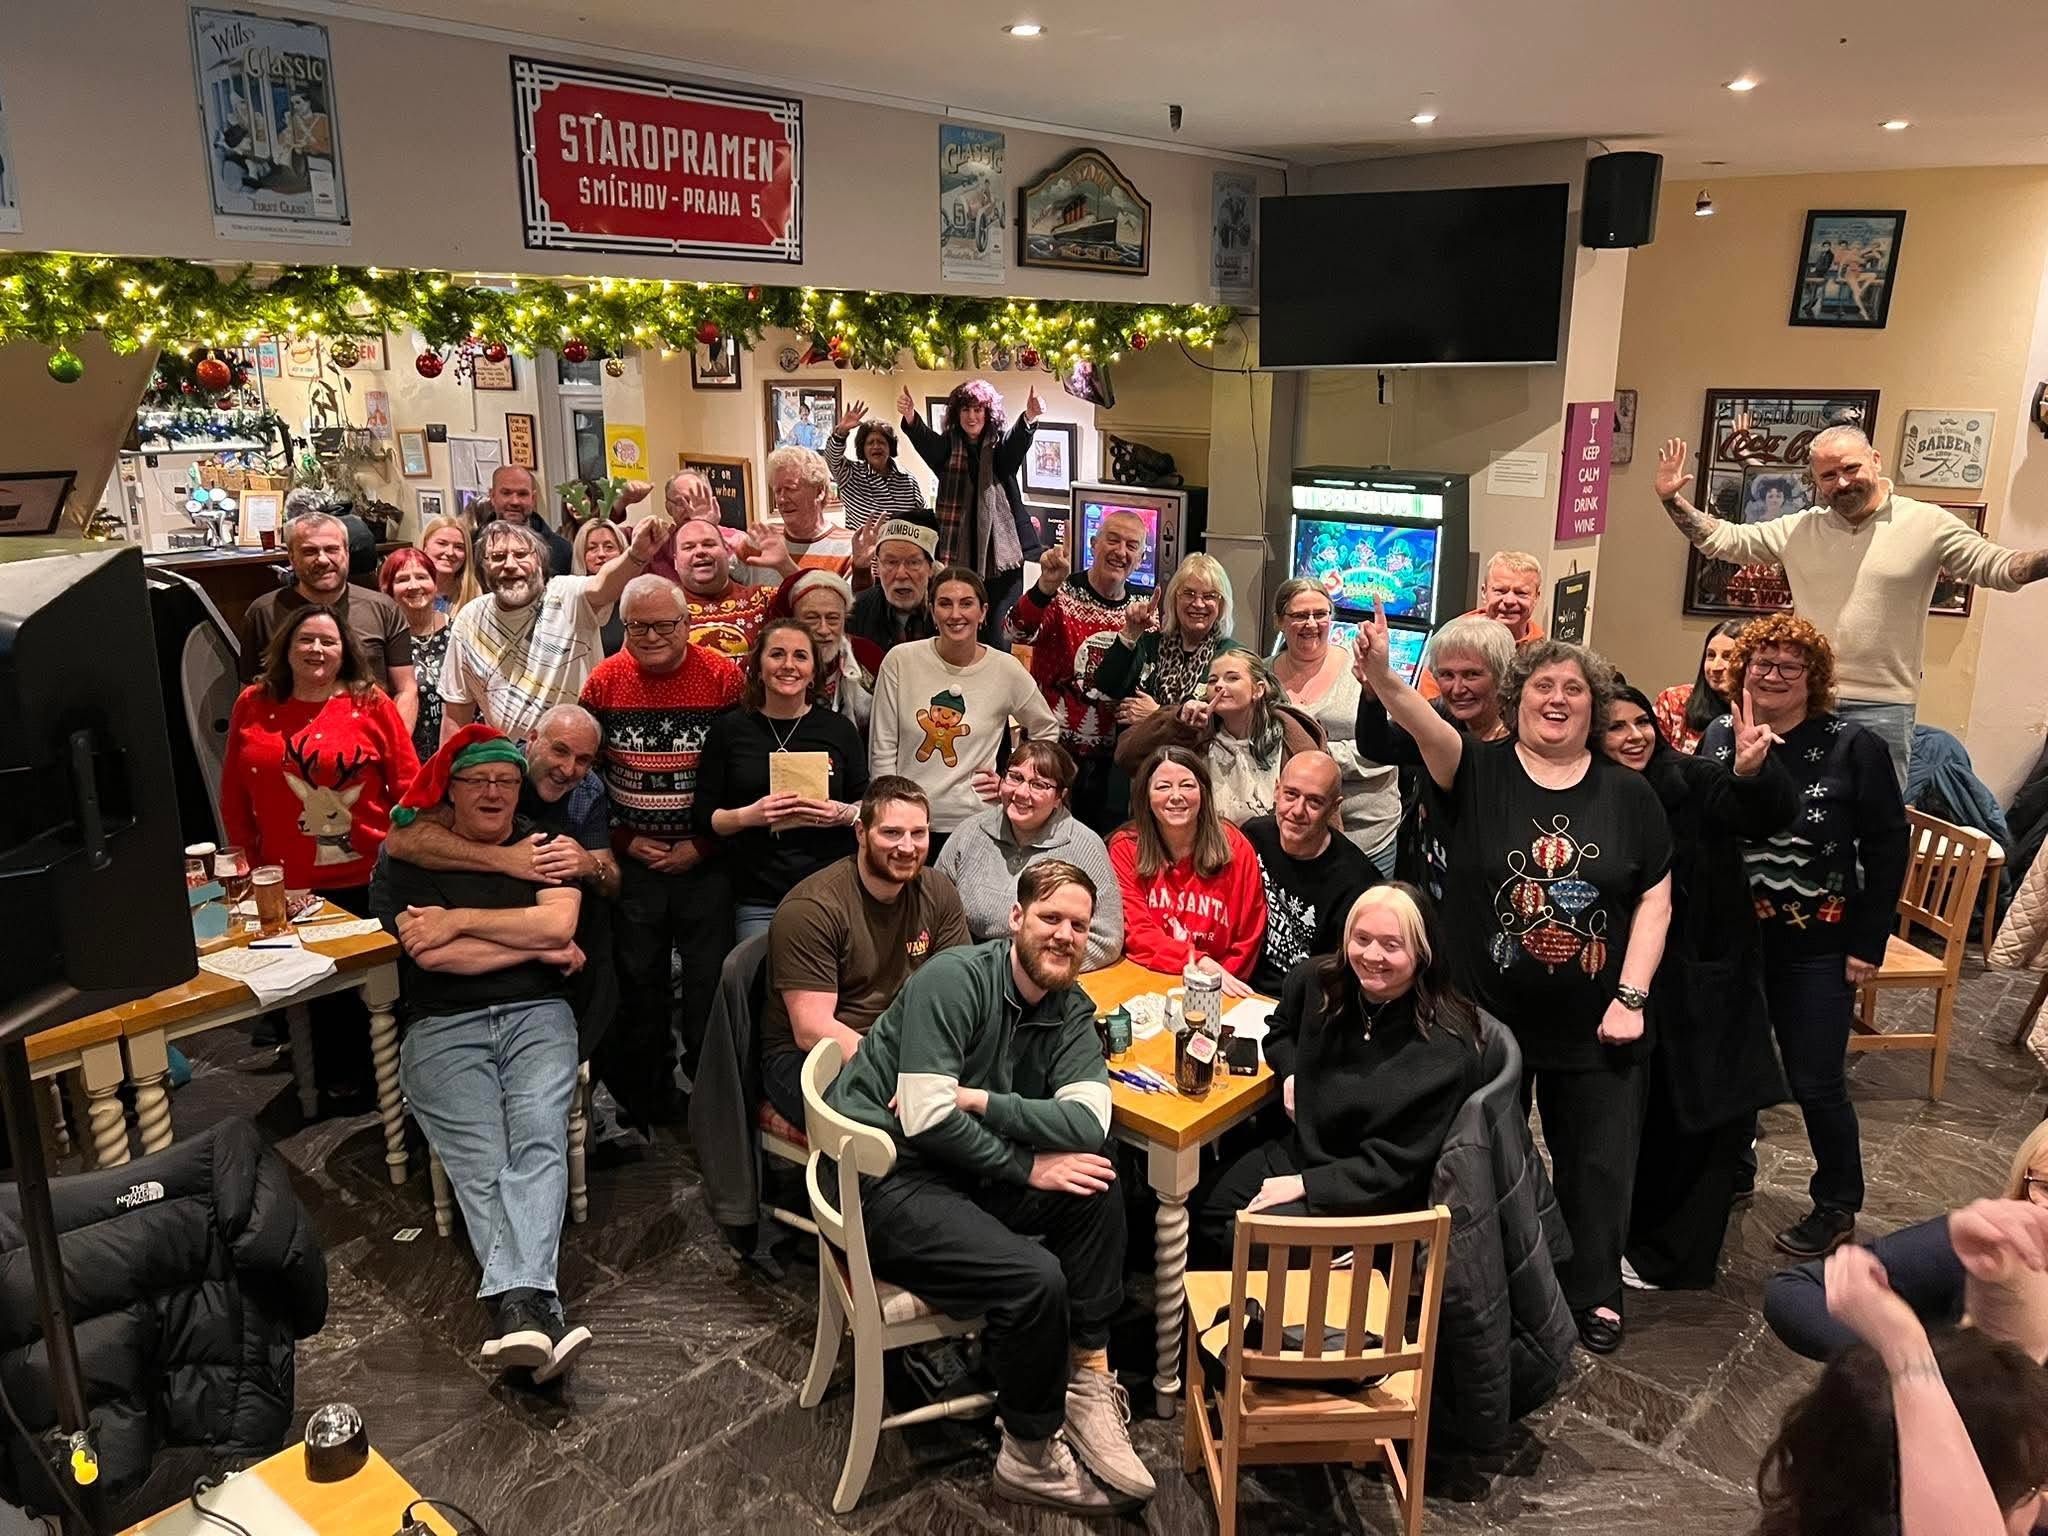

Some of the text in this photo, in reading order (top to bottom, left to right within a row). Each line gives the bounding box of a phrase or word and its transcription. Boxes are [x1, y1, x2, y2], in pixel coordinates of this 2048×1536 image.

[559, 113, 774, 182] STAROPRAMEN
[751, 194, 761, 218] 5
[1917, 435, 1972, 454] BARBER
[1582, 445, 1600, 461] KEEP
[1578, 466, 1600, 483] CALM
[715, 484, 736, 498] when
[1582, 485, 1593, 494] AND
[1574, 498, 1598, 513] DRINK
[1574, 517, 1596, 533] WINE
[1177, 890, 1230, 929] SANTA
[116, 1188, 149, 1205] NORTH
[129, 1183, 148, 1194] THE
[126, 1197, 149, 1208] FACE
